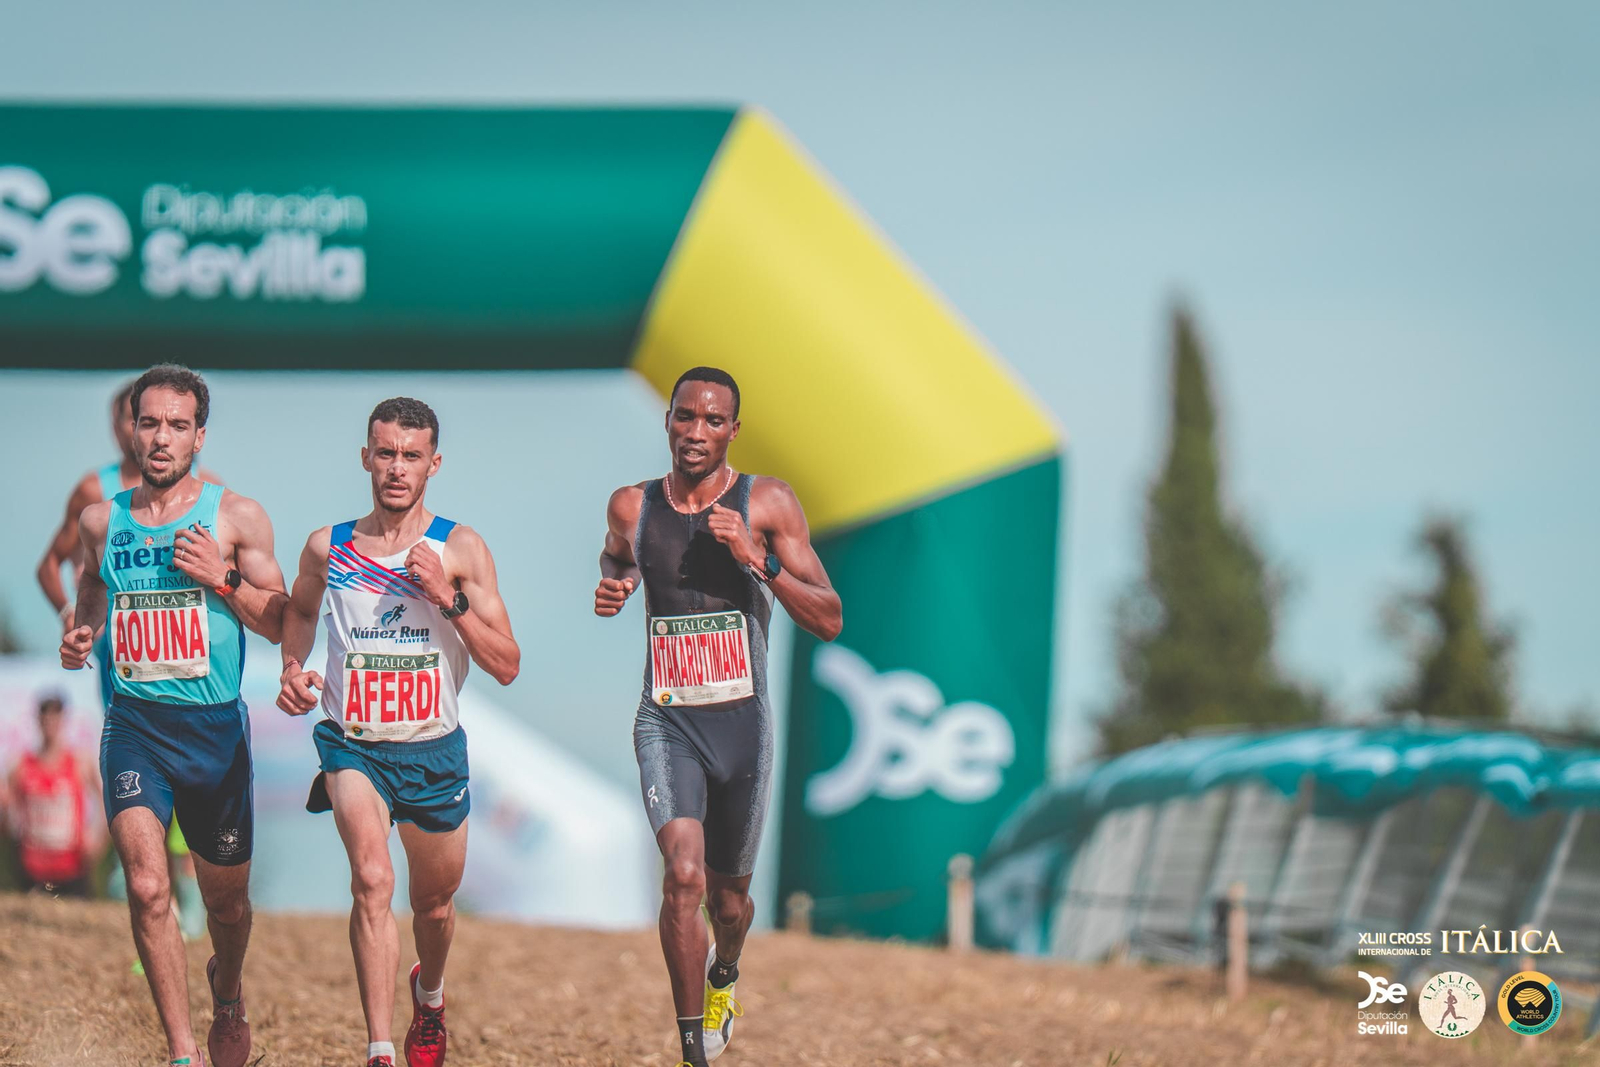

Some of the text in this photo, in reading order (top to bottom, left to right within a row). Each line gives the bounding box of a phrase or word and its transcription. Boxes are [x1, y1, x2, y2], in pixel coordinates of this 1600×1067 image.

[141, 229, 366, 301] Sevilla
[127, 576, 194, 591] ATLETISMO
[134, 594, 178, 606] ITÁLICA
[350, 626, 430, 639] Núñez Run
[672, 618, 718, 632] ITÁLICA
[115, 608, 206, 663] AOUINA
[371, 655, 417, 668] ITÁLICA
[652, 630, 748, 688] NTAKARUTIMANA
[345, 668, 441, 723] AFERDI
